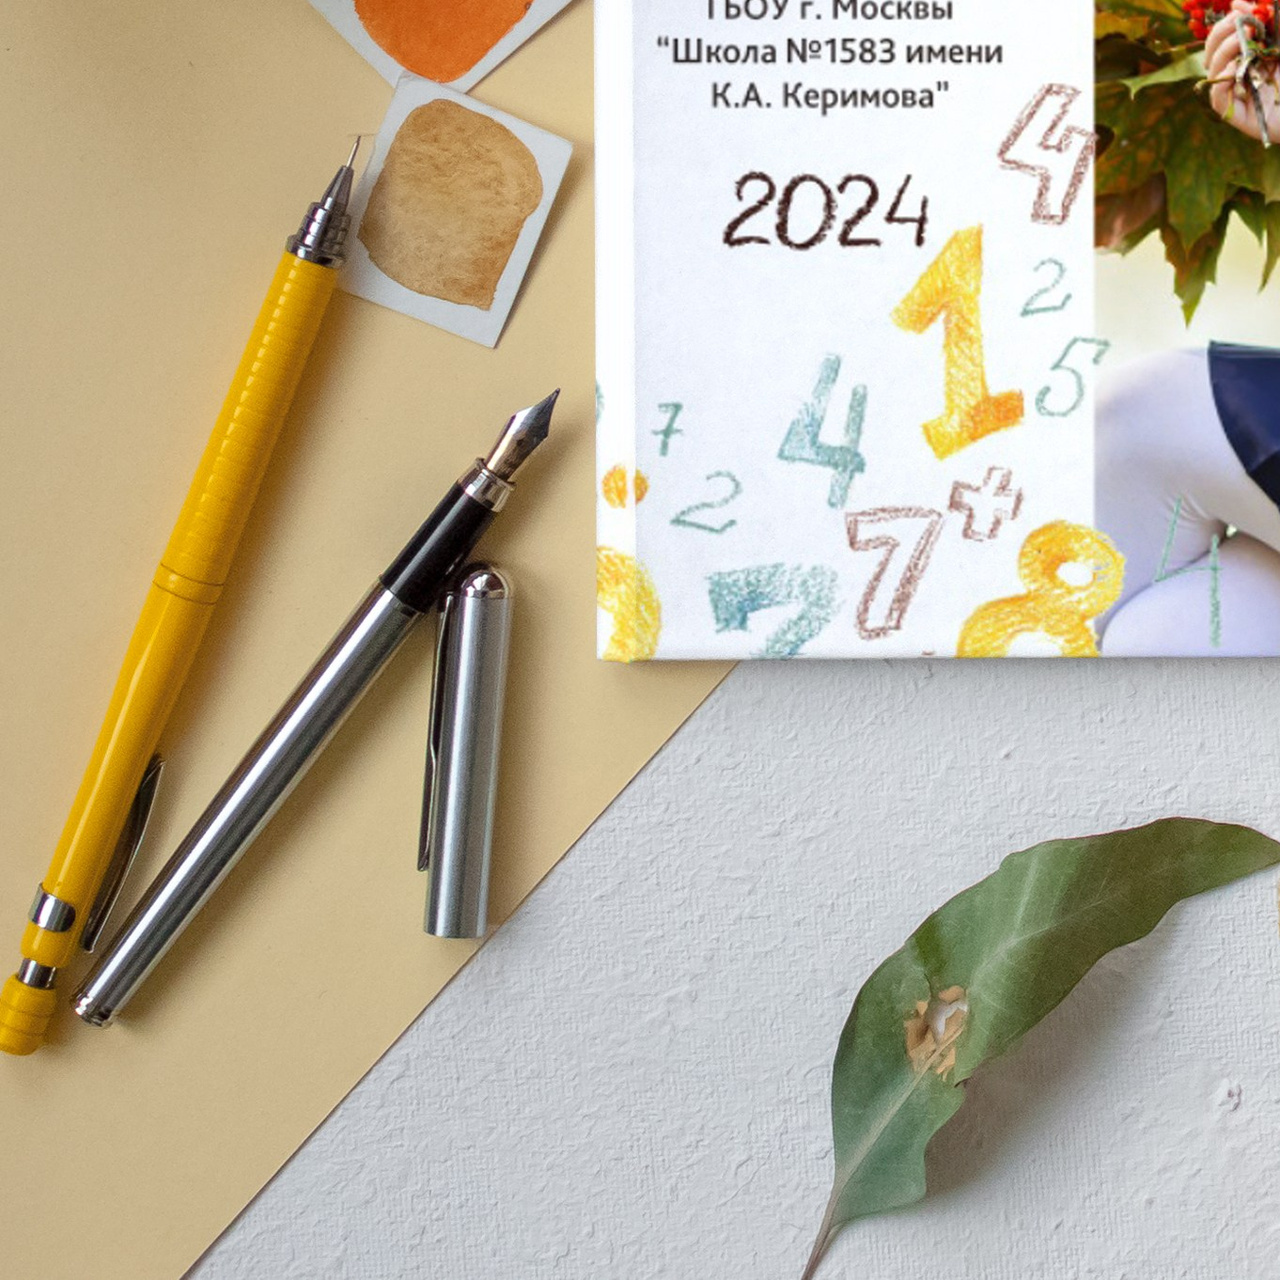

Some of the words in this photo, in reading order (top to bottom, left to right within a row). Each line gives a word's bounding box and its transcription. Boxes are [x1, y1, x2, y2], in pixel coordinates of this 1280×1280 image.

[800, 0, 822, 20] г.
[787, 37, 896, 64] №1583
[906, 44, 1003, 64] имени
[712, 82, 771, 108] К.А.
[783, 80, 949, 117] Керимова"
[997, 83, 1097, 226] 4
[722, 172, 929, 250] 2024
[1020, 257, 1072, 317] 2
[890, 223, 1025, 462] 1
[1035, 337, 1111, 419] 5
[652, 402, 683, 456] 7
[776, 353, 868, 510] 4
[670, 469, 742, 534] 2
[845, 506, 943, 641] 7
[1154, 496, 1223, 649] 4
